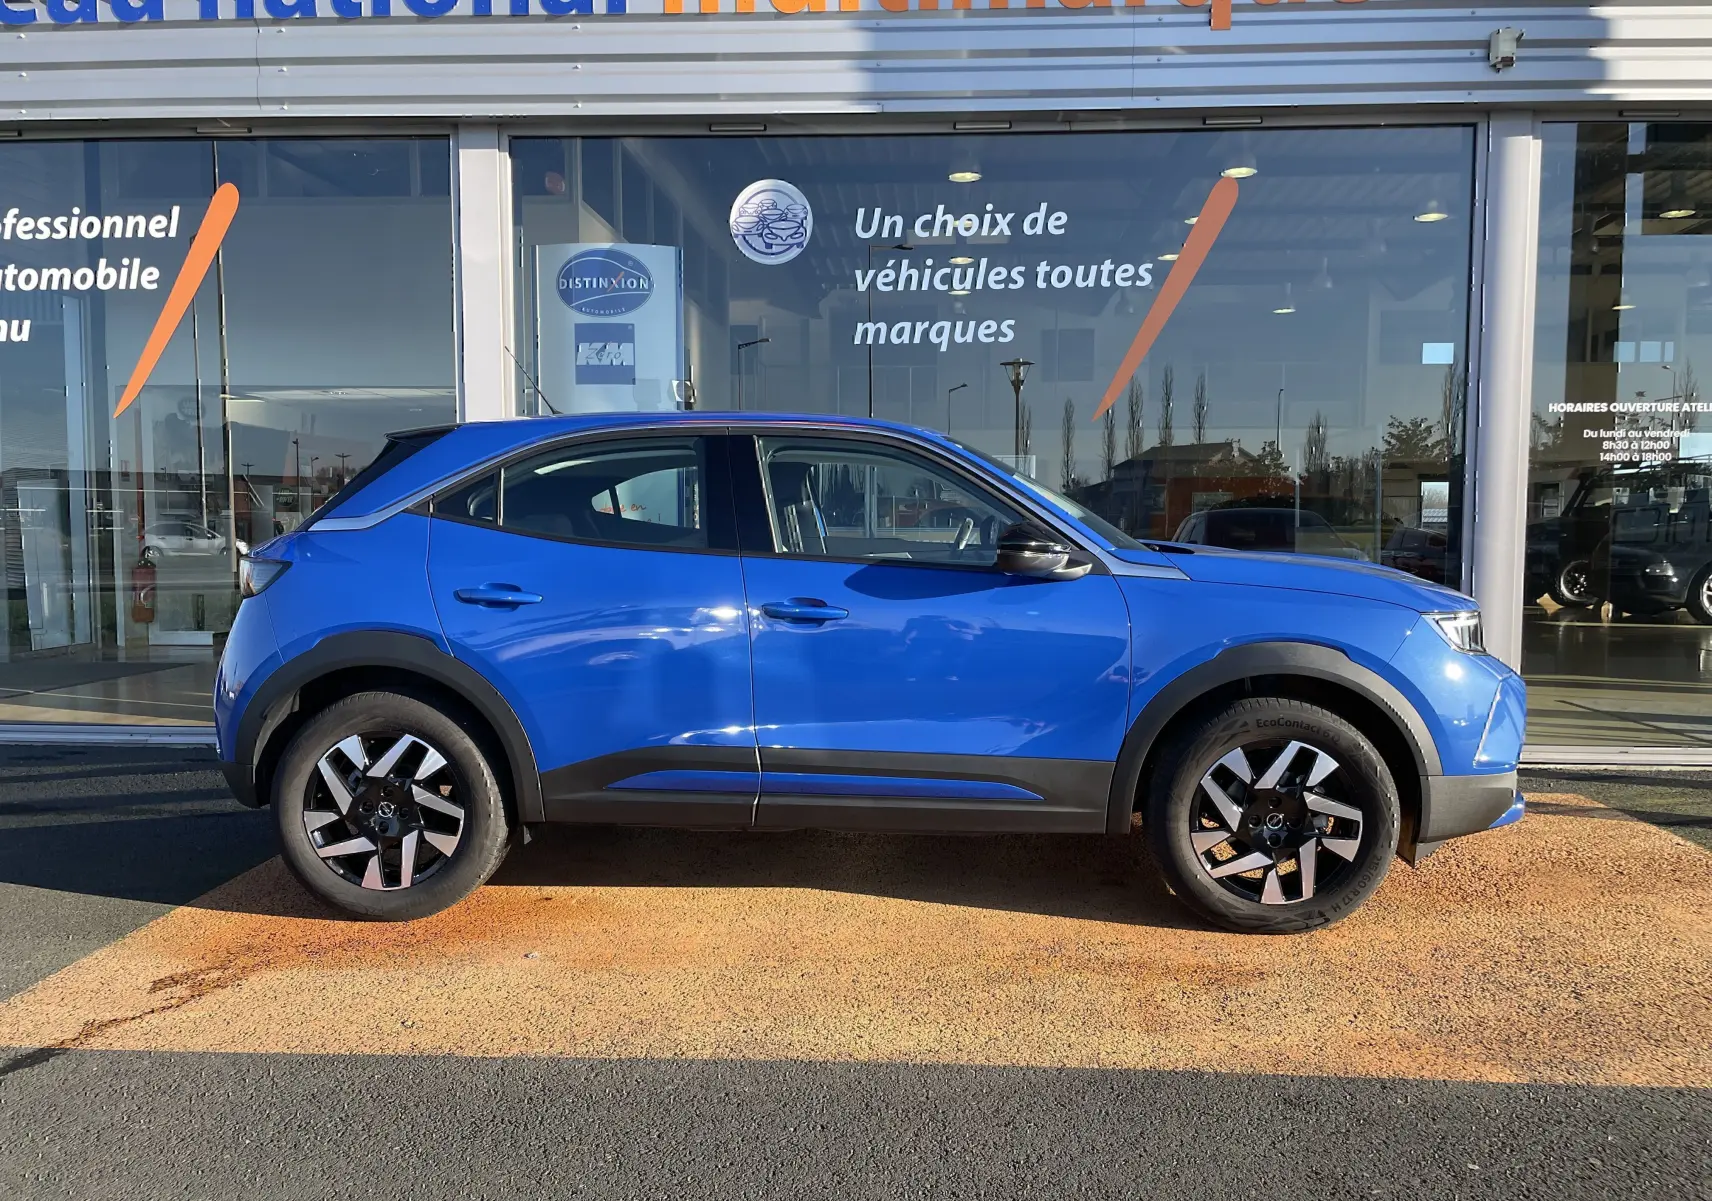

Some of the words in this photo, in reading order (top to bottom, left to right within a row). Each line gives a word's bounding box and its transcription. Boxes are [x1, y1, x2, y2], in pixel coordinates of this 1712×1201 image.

[0, 205, 181, 240] fessionnel
[855, 207, 903, 239] Un
[914, 203, 1016, 238] choix
[1022, 202, 1068, 235] de
[0, 257, 160, 291] tomobile
[559, 274, 649, 290] DISTINXION
[854, 257, 1026, 292] véhicules
[1036, 258, 1154, 289] toutes
[853, 317, 1016, 352] marques
[1548, 402, 1608, 413] HORAIRES
[1609, 402, 1680, 413] OUVERTURE
[1583, 429, 1598, 438] Du
[1599, 428, 1626, 438] lundi
[1627, 430, 1642, 438] au
[1644, 428, 1691, 438] vendredi
[1602, 440, 1629, 450] 8h30
[1630, 440, 1639, 450] à
[1640, 440, 1670, 450] 12h00
[1599, 452, 1630, 462] 14h00
[1631, 452, 1640, 461] à
[1641, 452, 1672, 461] 18h00
[1256, 717, 1320, 734] EcoContact
